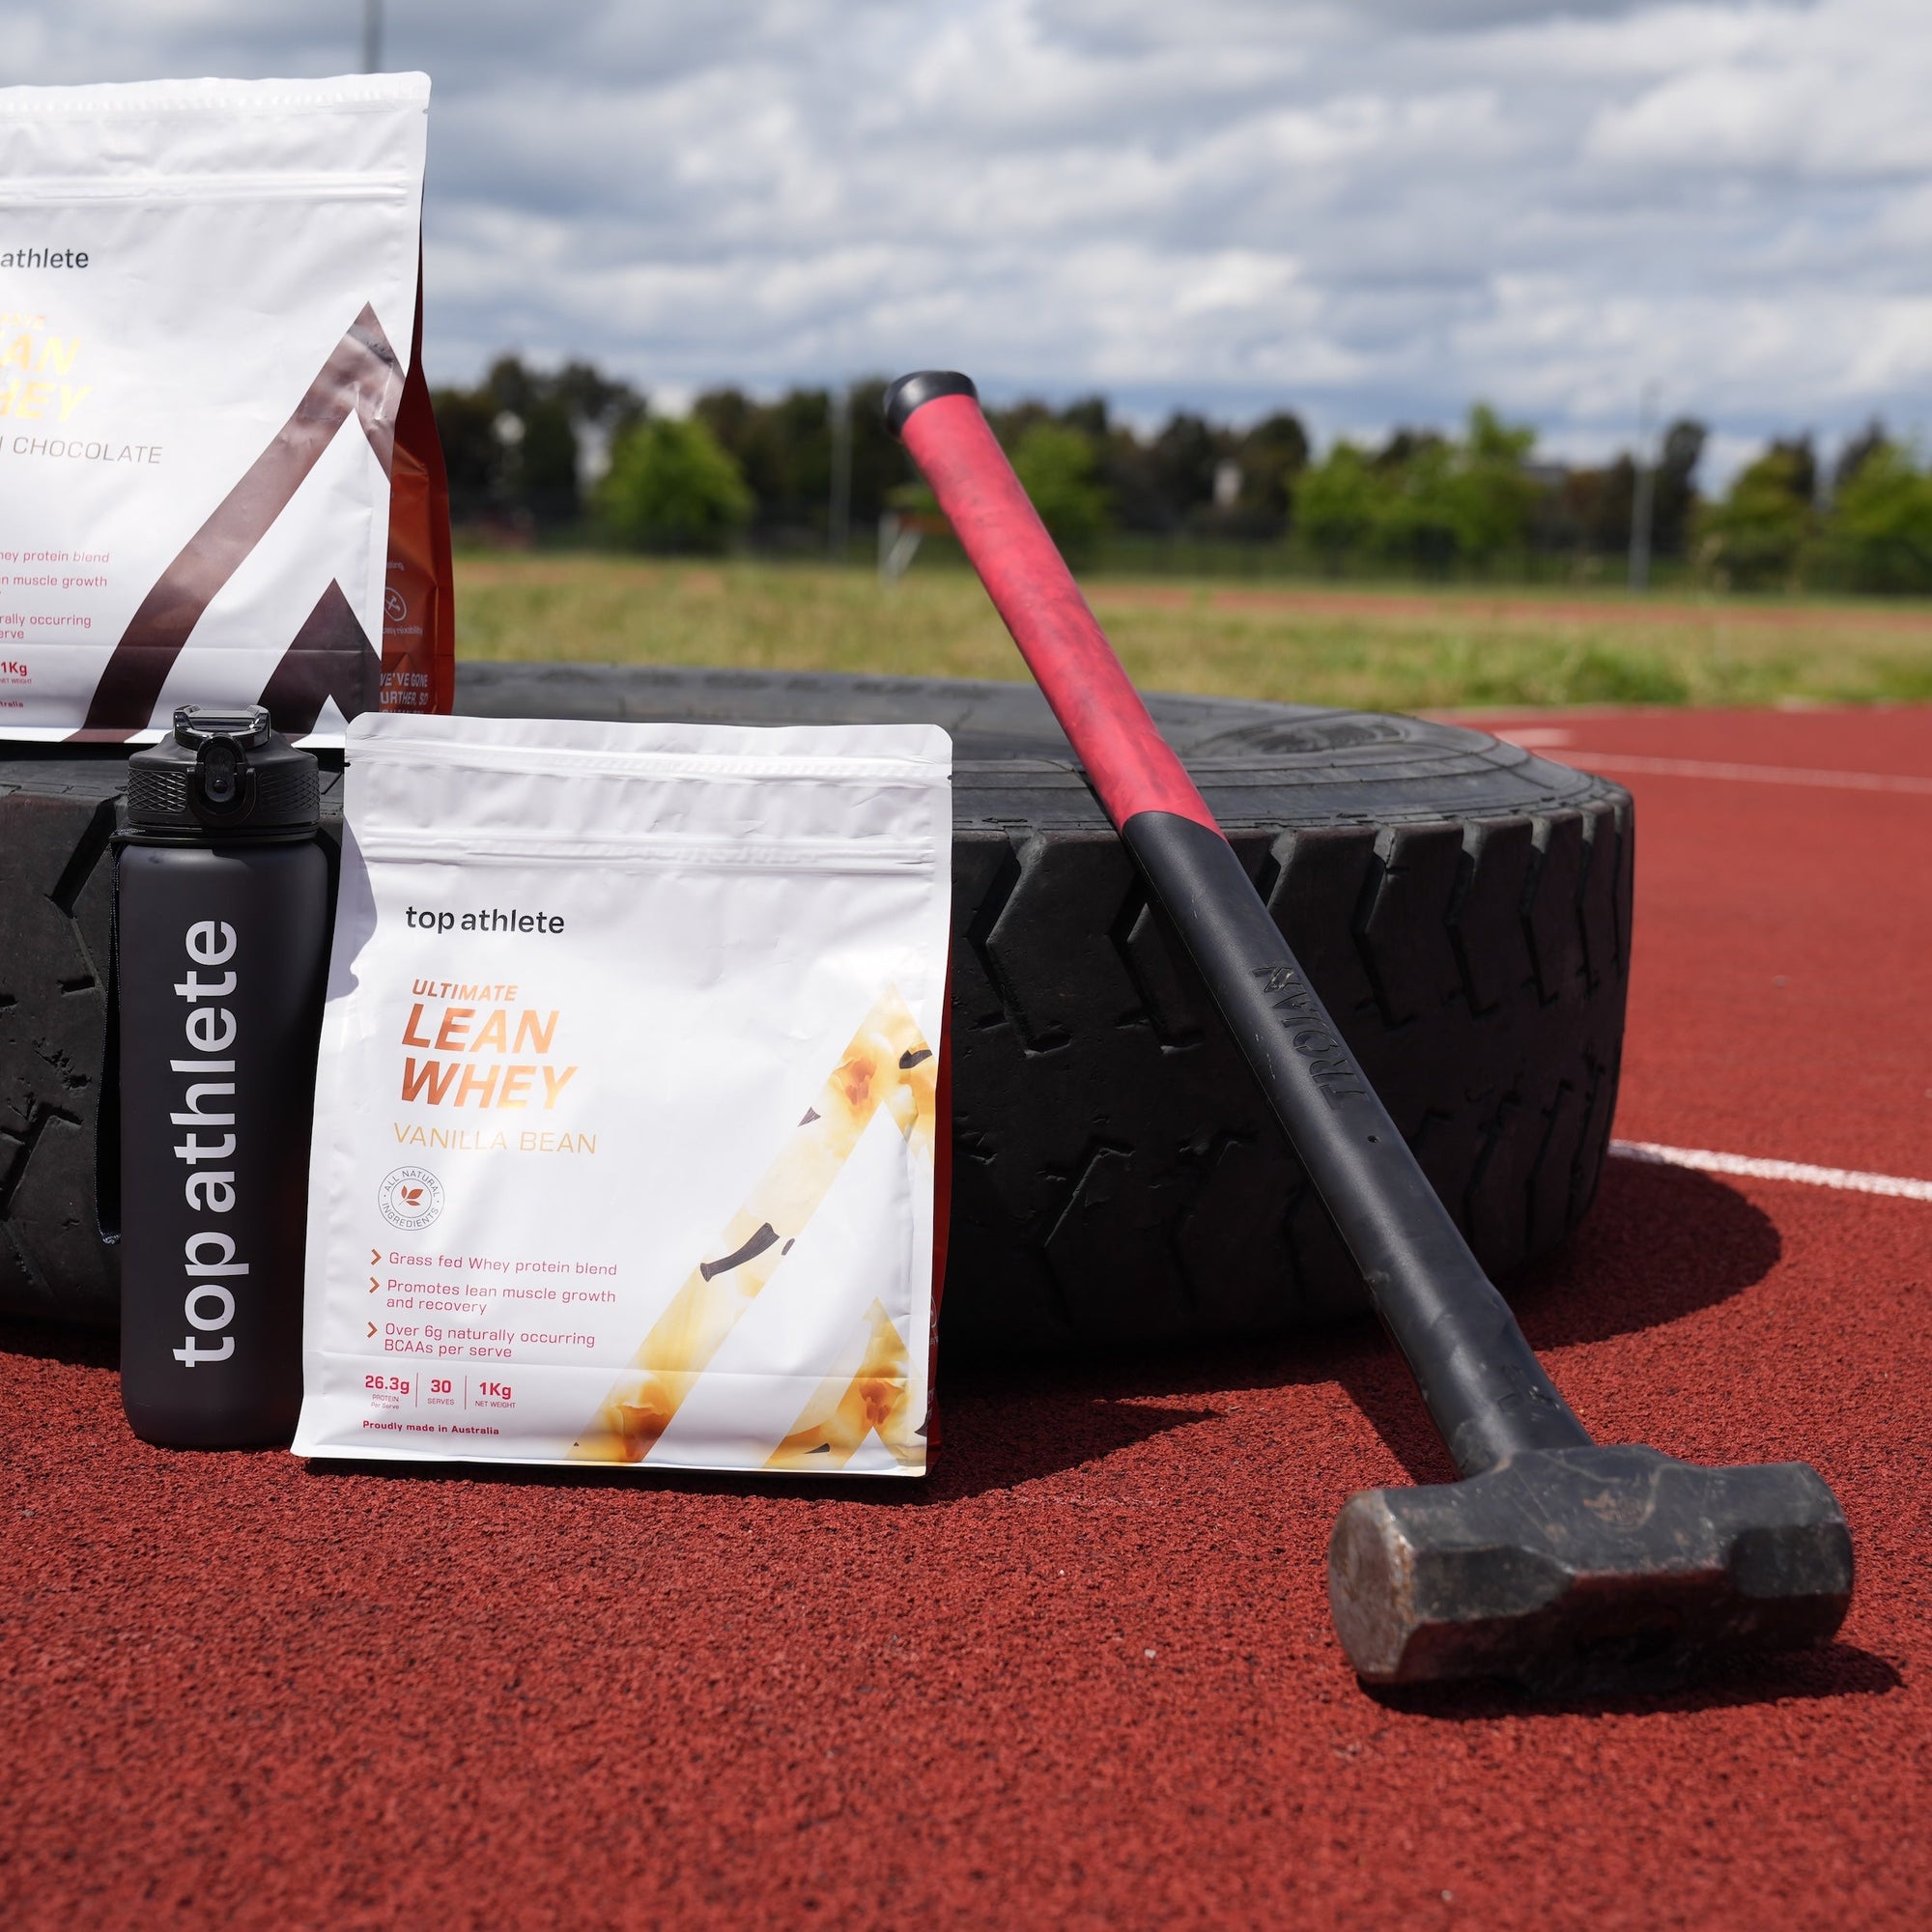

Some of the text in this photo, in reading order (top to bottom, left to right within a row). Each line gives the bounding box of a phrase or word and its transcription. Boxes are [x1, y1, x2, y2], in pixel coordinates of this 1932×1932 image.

[0, 247, 89, 269] athlete
[0, 333, 82, 376] AN
[13, 436, 163, 464] CHOCOLATE
[23, 551, 69, 563] protein
[73, 552, 110, 563] blend
[14, 575, 57, 586] muscle
[63, 576, 108, 588] growth
[30, 614, 92, 628] occurring
[1, 662, 28, 676] 1Kg
[411, 673, 428, 688] GONE
[419, 693, 429, 705] SO
[406, 906, 565, 934] top athlete
[412, 979, 518, 1002] ULTIMATE
[402, 1003, 559, 1054] LEAN
[1252, 966, 1370, 1111] TROJAN
[401, 1057, 579, 1110] WHEY
[169, 920, 250, 1368] top athlete
[394, 1122, 596, 1154] VANILLA BEAN
[384, 1170, 440, 1197] ALL NATURAL
[383, 1203, 439, 1228] INGREDIENTS
[389, 1252, 617, 1276] Grass fed Whey protein blend
[387, 1279, 616, 1303] Promotes lean muscle growth
[386, 1297, 487, 1315] and recovery
[385, 1322, 595, 1348] Over 6g naturally occurring
[384, 1339, 512, 1358] BCAAs per serve
[365, 1375, 410, 1394] 26.3g
[431, 1379, 451, 1393] 30
[479, 1381, 512, 1400] 1Kg
[372, 1394, 399, 1403] PROTEIN
[363, 1420, 499, 1435] Proudly made in Australia
